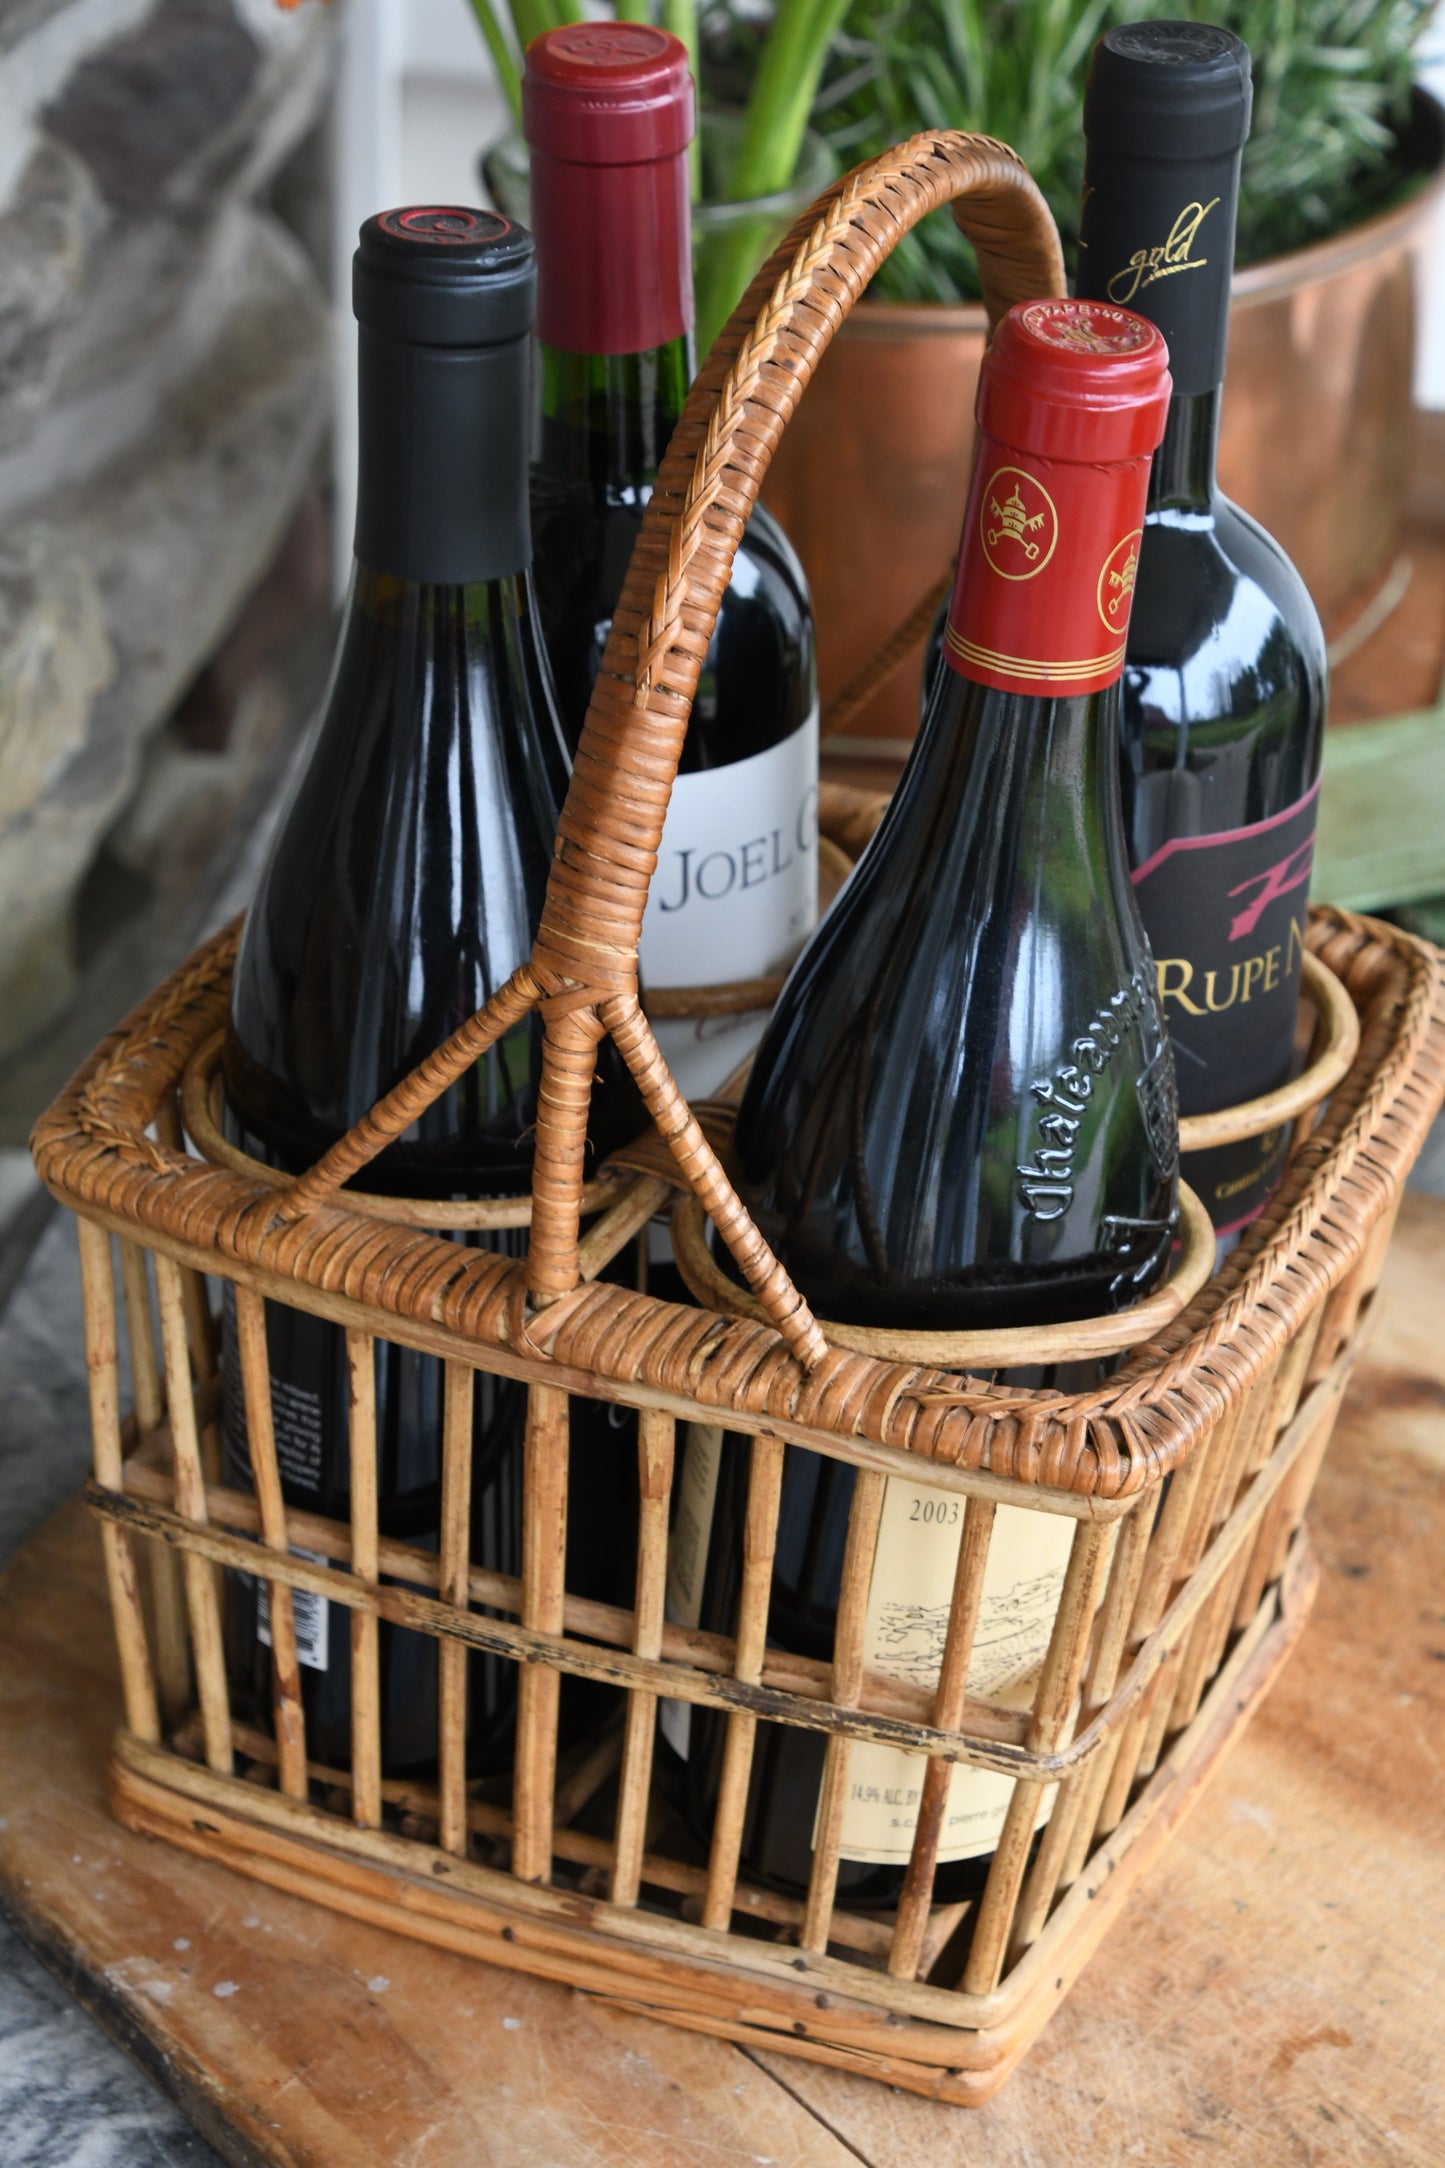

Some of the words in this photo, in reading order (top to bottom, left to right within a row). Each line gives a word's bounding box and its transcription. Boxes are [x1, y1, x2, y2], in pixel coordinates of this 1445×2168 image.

[1107, 197, 1221, 304] gold
[659, 829, 794, 913] JOEL
[1153, 944, 1282, 1021] RUPE
[909, 1498, 960, 1524] 2003
